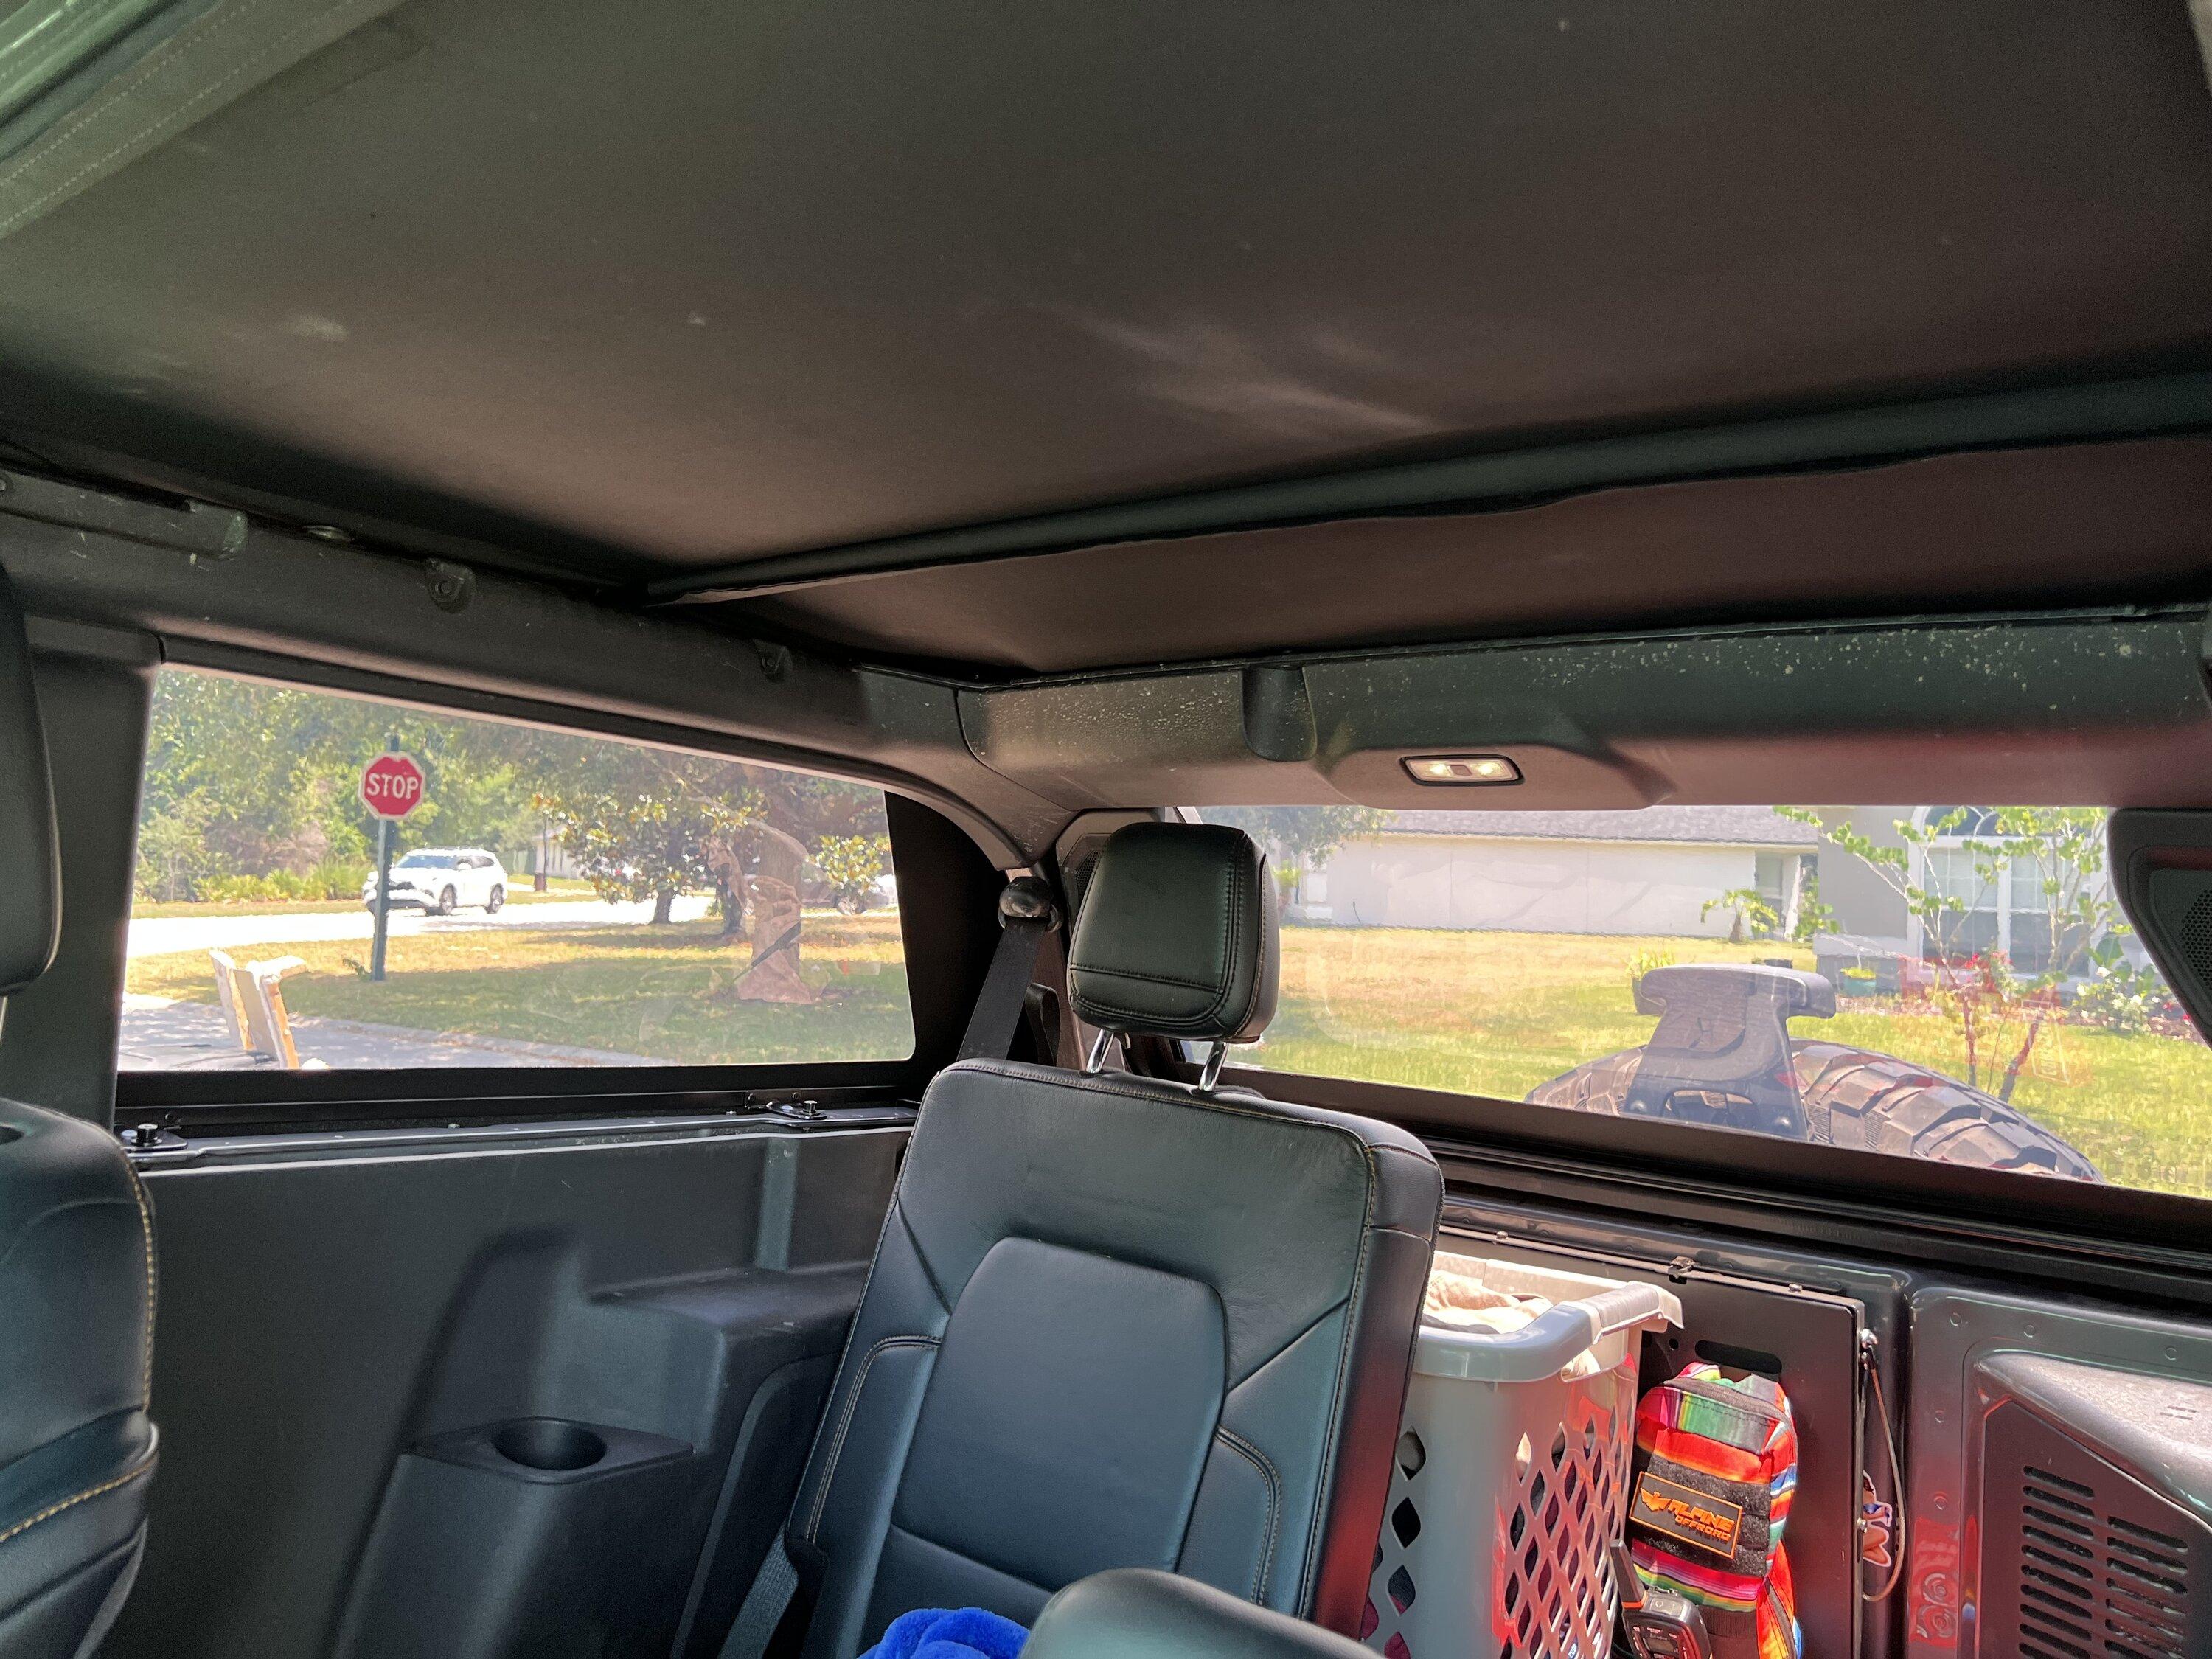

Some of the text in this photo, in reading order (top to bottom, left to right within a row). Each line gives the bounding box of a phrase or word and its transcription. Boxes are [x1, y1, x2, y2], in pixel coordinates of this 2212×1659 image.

[366, 772, 419, 800] STOP
[1668, 1498, 1736, 1534] ALPINE
[1674, 1514, 1732, 1543] OFFROAD
